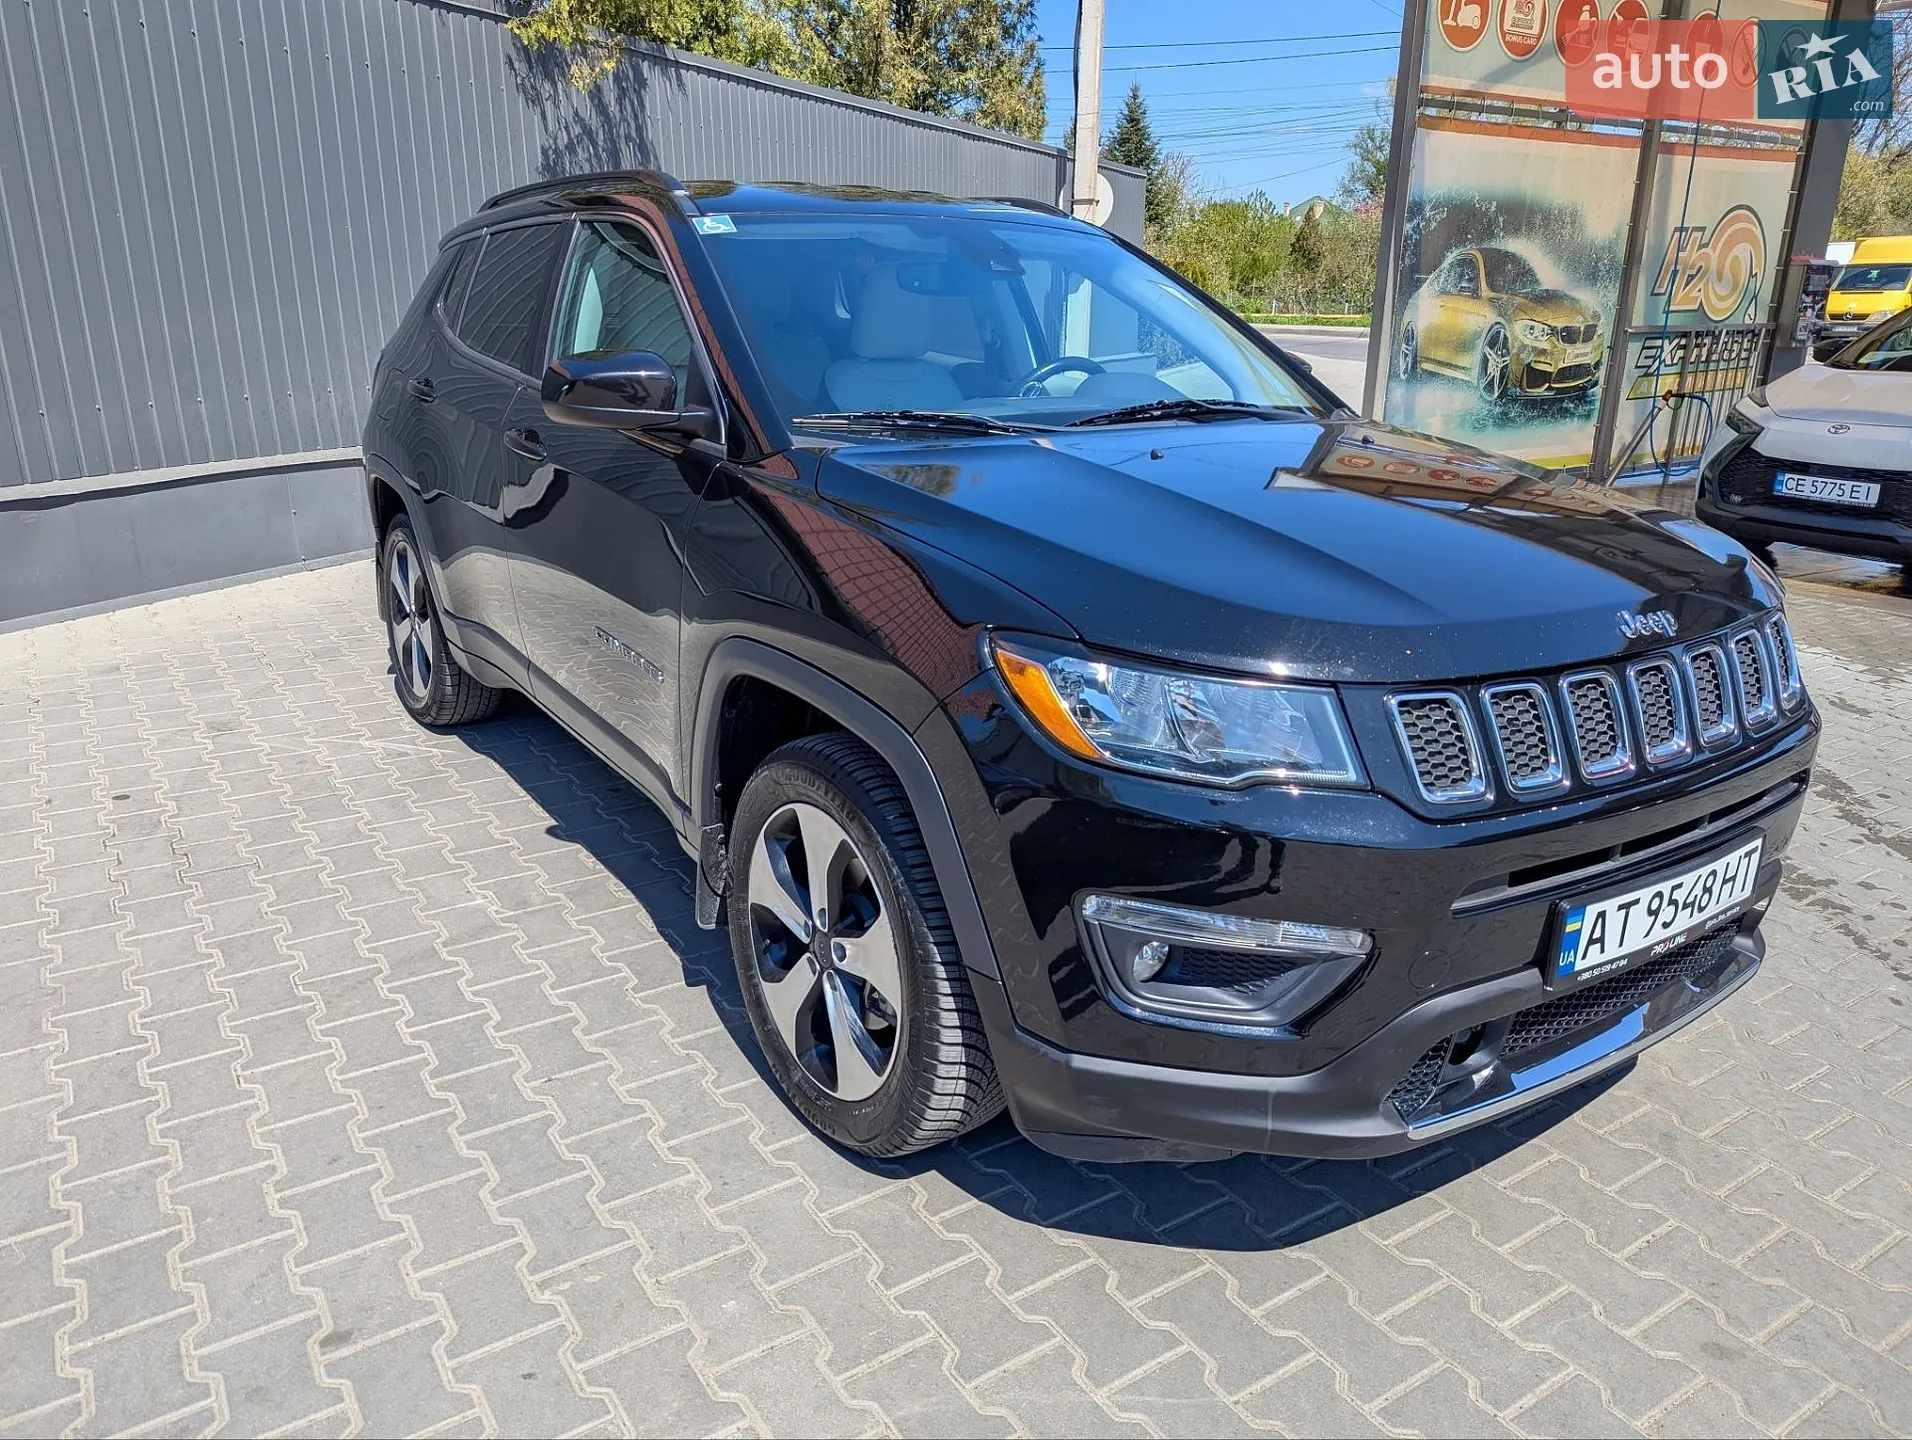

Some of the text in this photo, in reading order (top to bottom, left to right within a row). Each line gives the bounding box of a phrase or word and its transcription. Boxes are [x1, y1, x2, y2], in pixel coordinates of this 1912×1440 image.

[1505, 33, 1538, 46] BONUS CARD
[1784, 477, 1807, 492] CE
[1809, 479, 1846, 498] 5775
[1849, 484, 1871, 501] EI
[1617, 609, 1679, 639] Jeep
[1581, 845, 1760, 961] AT 9548 HT
[1559, 951, 1575, 967] UA
